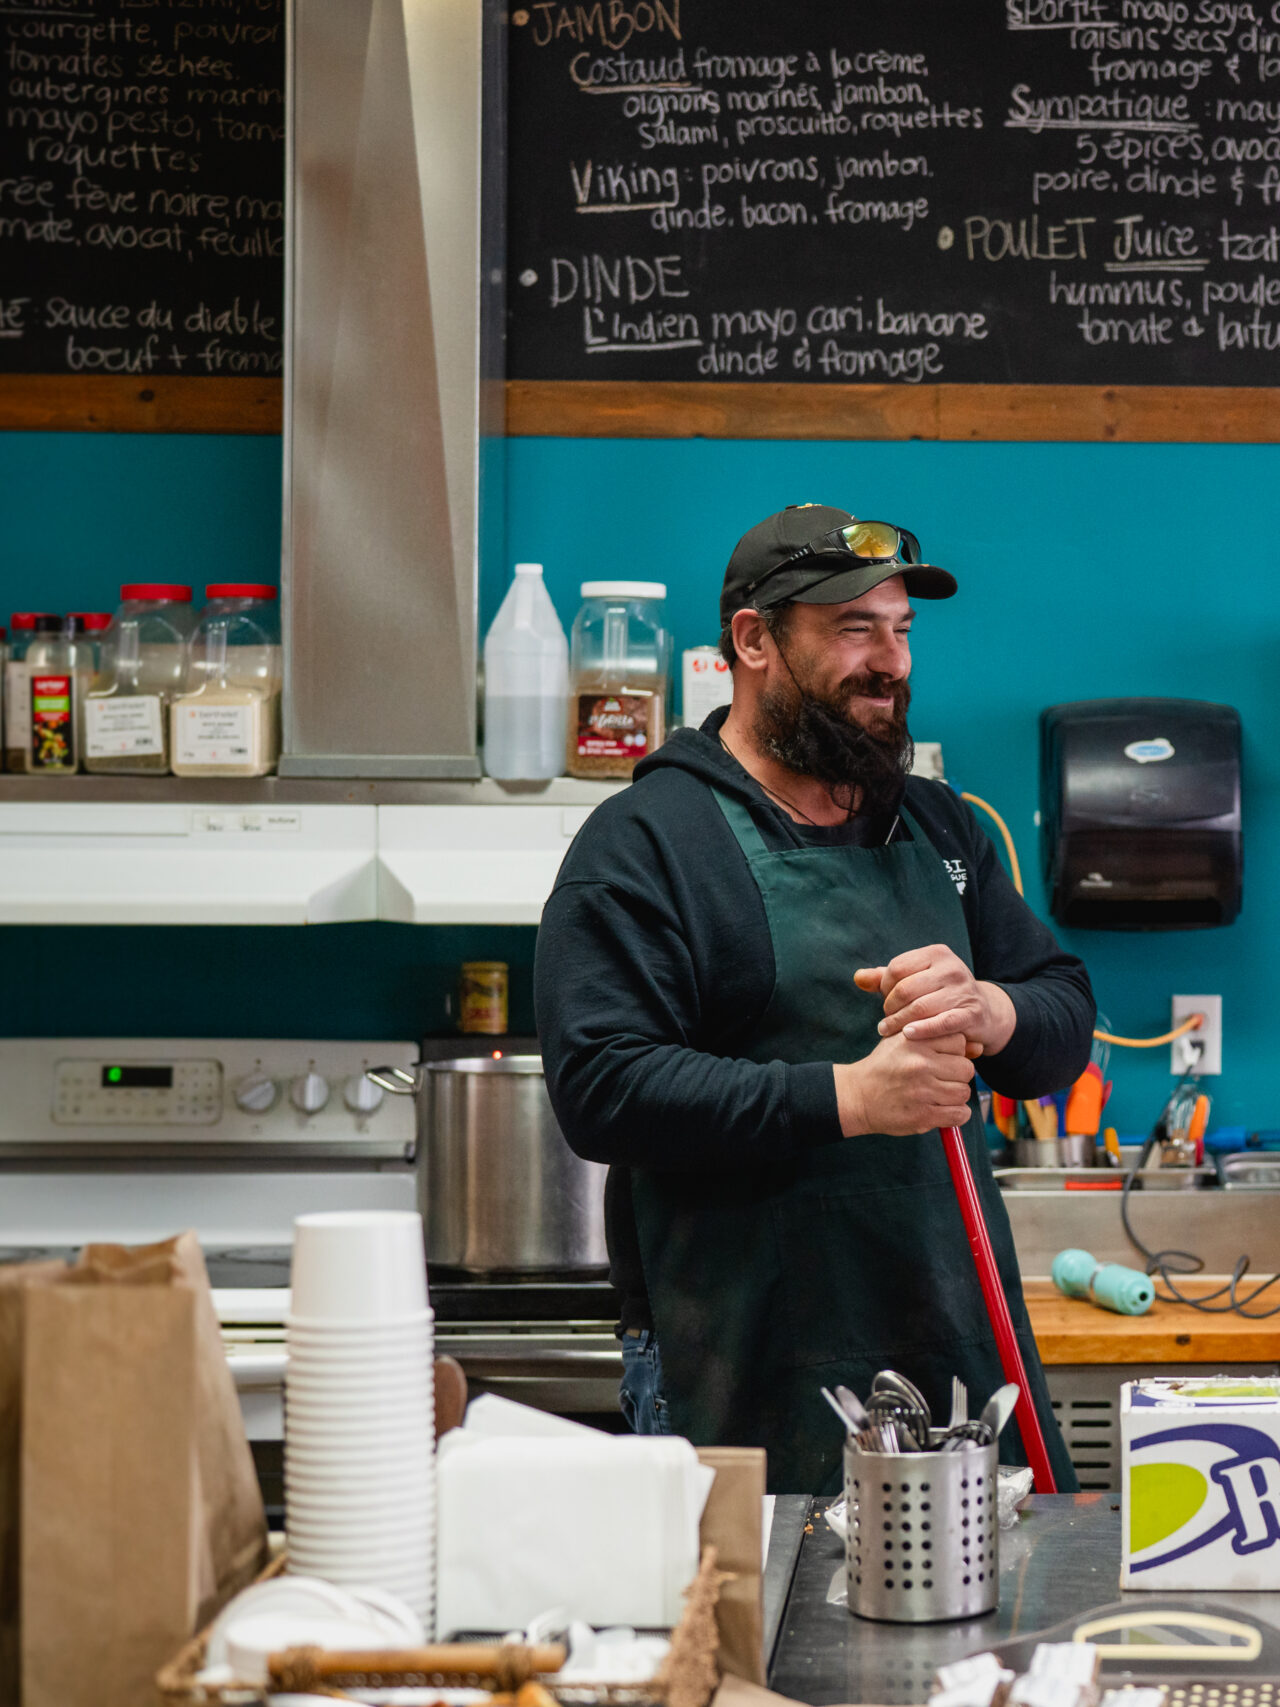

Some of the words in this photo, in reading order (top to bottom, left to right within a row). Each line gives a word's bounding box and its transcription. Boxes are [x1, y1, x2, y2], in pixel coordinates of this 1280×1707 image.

[532, 0, 682, 50] JAMBON
[1121, 0, 1189, 35] mayo
[1070, 26, 1160, 50] raisins
[7, 42, 123, 78] tomates
[570, 48, 688, 87] Costaud
[693, 46, 799, 89] fromage
[805, 51, 821, 72] à
[1088, 51, 1213, 91] fromage
[9, 77, 170, 114] aubergines
[623, 90, 721, 125] oignons
[7, 106, 99, 144] mayo
[860, 101, 984, 138] roquettes
[27, 136, 202, 176] roquettes
[1075, 133, 1099, 165] 5
[1126, 163, 1217, 199] dinde
[824, 192, 930, 232] fromage
[965, 214, 1097, 261] POULET
[552, 255, 690, 305] DINDE
[138, 300, 174, 331] du
[184, 297, 278, 340] diable
[712, 308, 796, 341] mayo
[876, 298, 988, 340] banane
[1077, 306, 1174, 345] tomate
[698, 340, 779, 376] dinde
[818, 338, 944, 384] fromage
